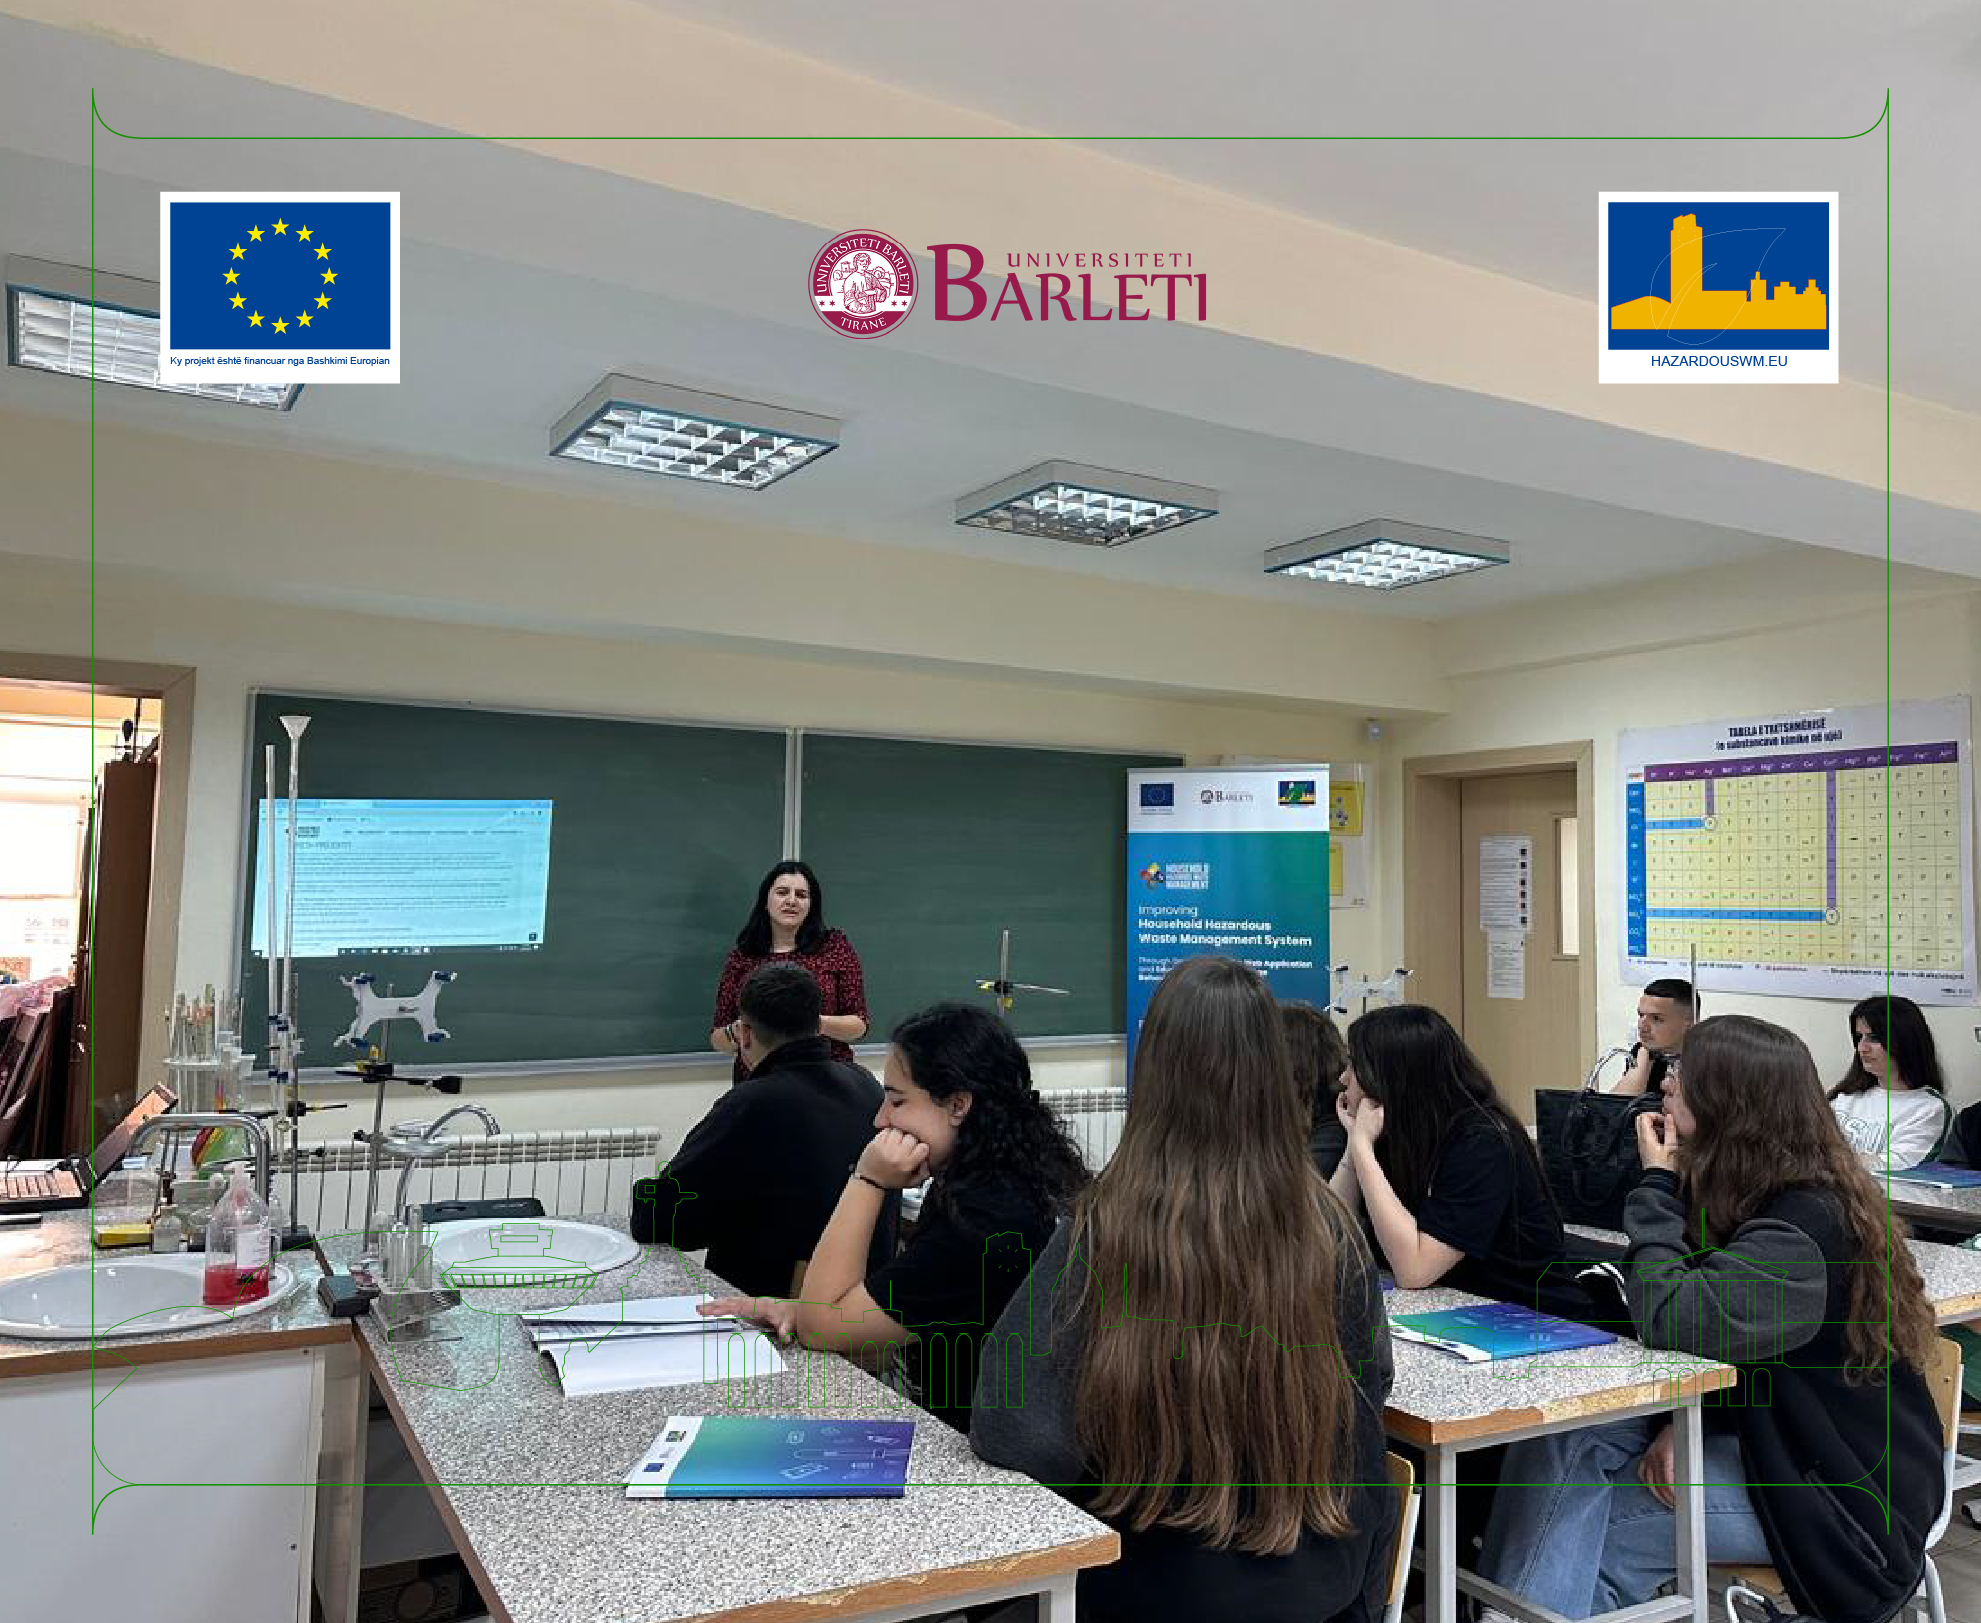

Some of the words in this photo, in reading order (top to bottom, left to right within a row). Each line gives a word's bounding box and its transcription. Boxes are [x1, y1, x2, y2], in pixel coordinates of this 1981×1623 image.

[1728, 726, 1757, 737] TABELA
[1138, 905, 1198, 917] Improving
[1138, 919, 1202, 929] Household
[1205, 919, 1272, 931] Hazardous
[1138, 934, 1178, 944] Waste
[1180, 934, 1262, 947] Management
[1264, 935, 1312, 949] System
